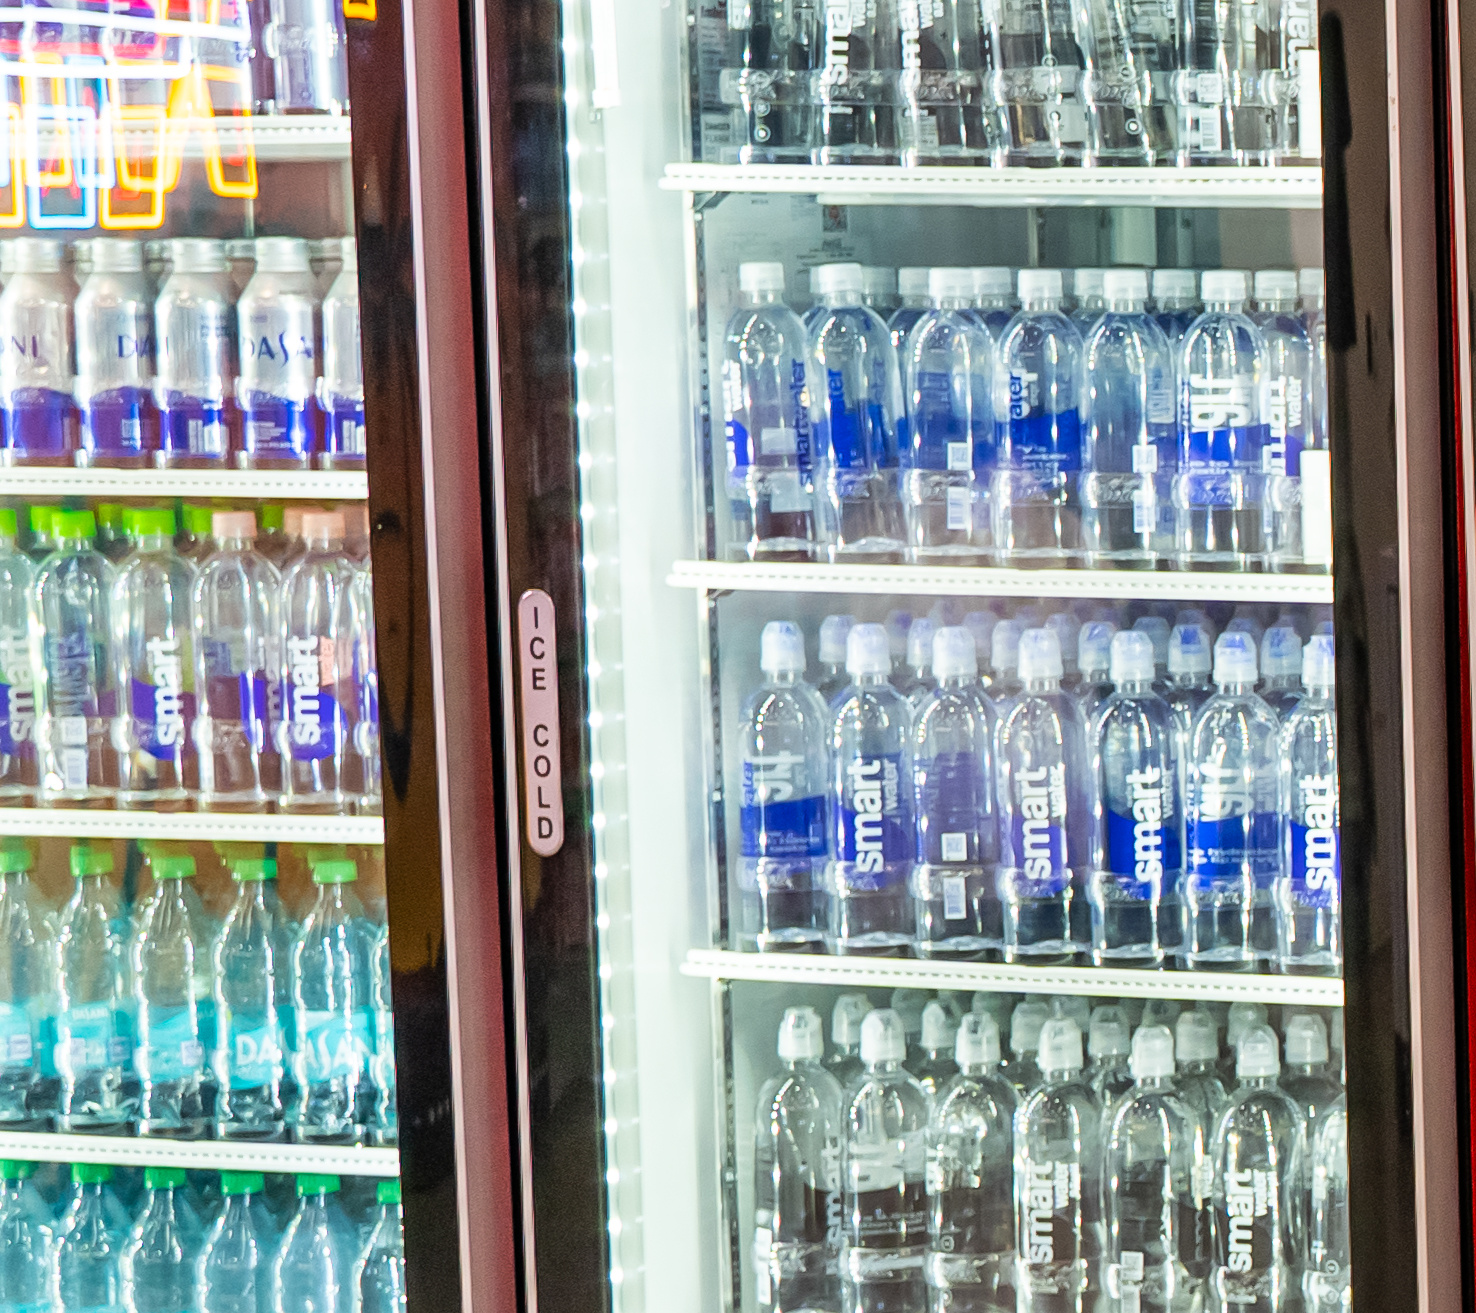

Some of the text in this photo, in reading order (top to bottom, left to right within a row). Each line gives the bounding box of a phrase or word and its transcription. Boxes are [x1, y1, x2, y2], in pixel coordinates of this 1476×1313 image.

[146, 636, 181, 746] smart
[291, 636, 321, 746] smart
[530, 606, 554, 840] ICE COLD
[855, 758, 884, 875] smart
[1023, 765, 1051, 882] smart
[1133, 768, 1163, 887] smart
[1303, 774, 1331, 891] smart
[1028, 1160, 1054, 1265] smart
[1226, 1167, 1255, 1275] smart
